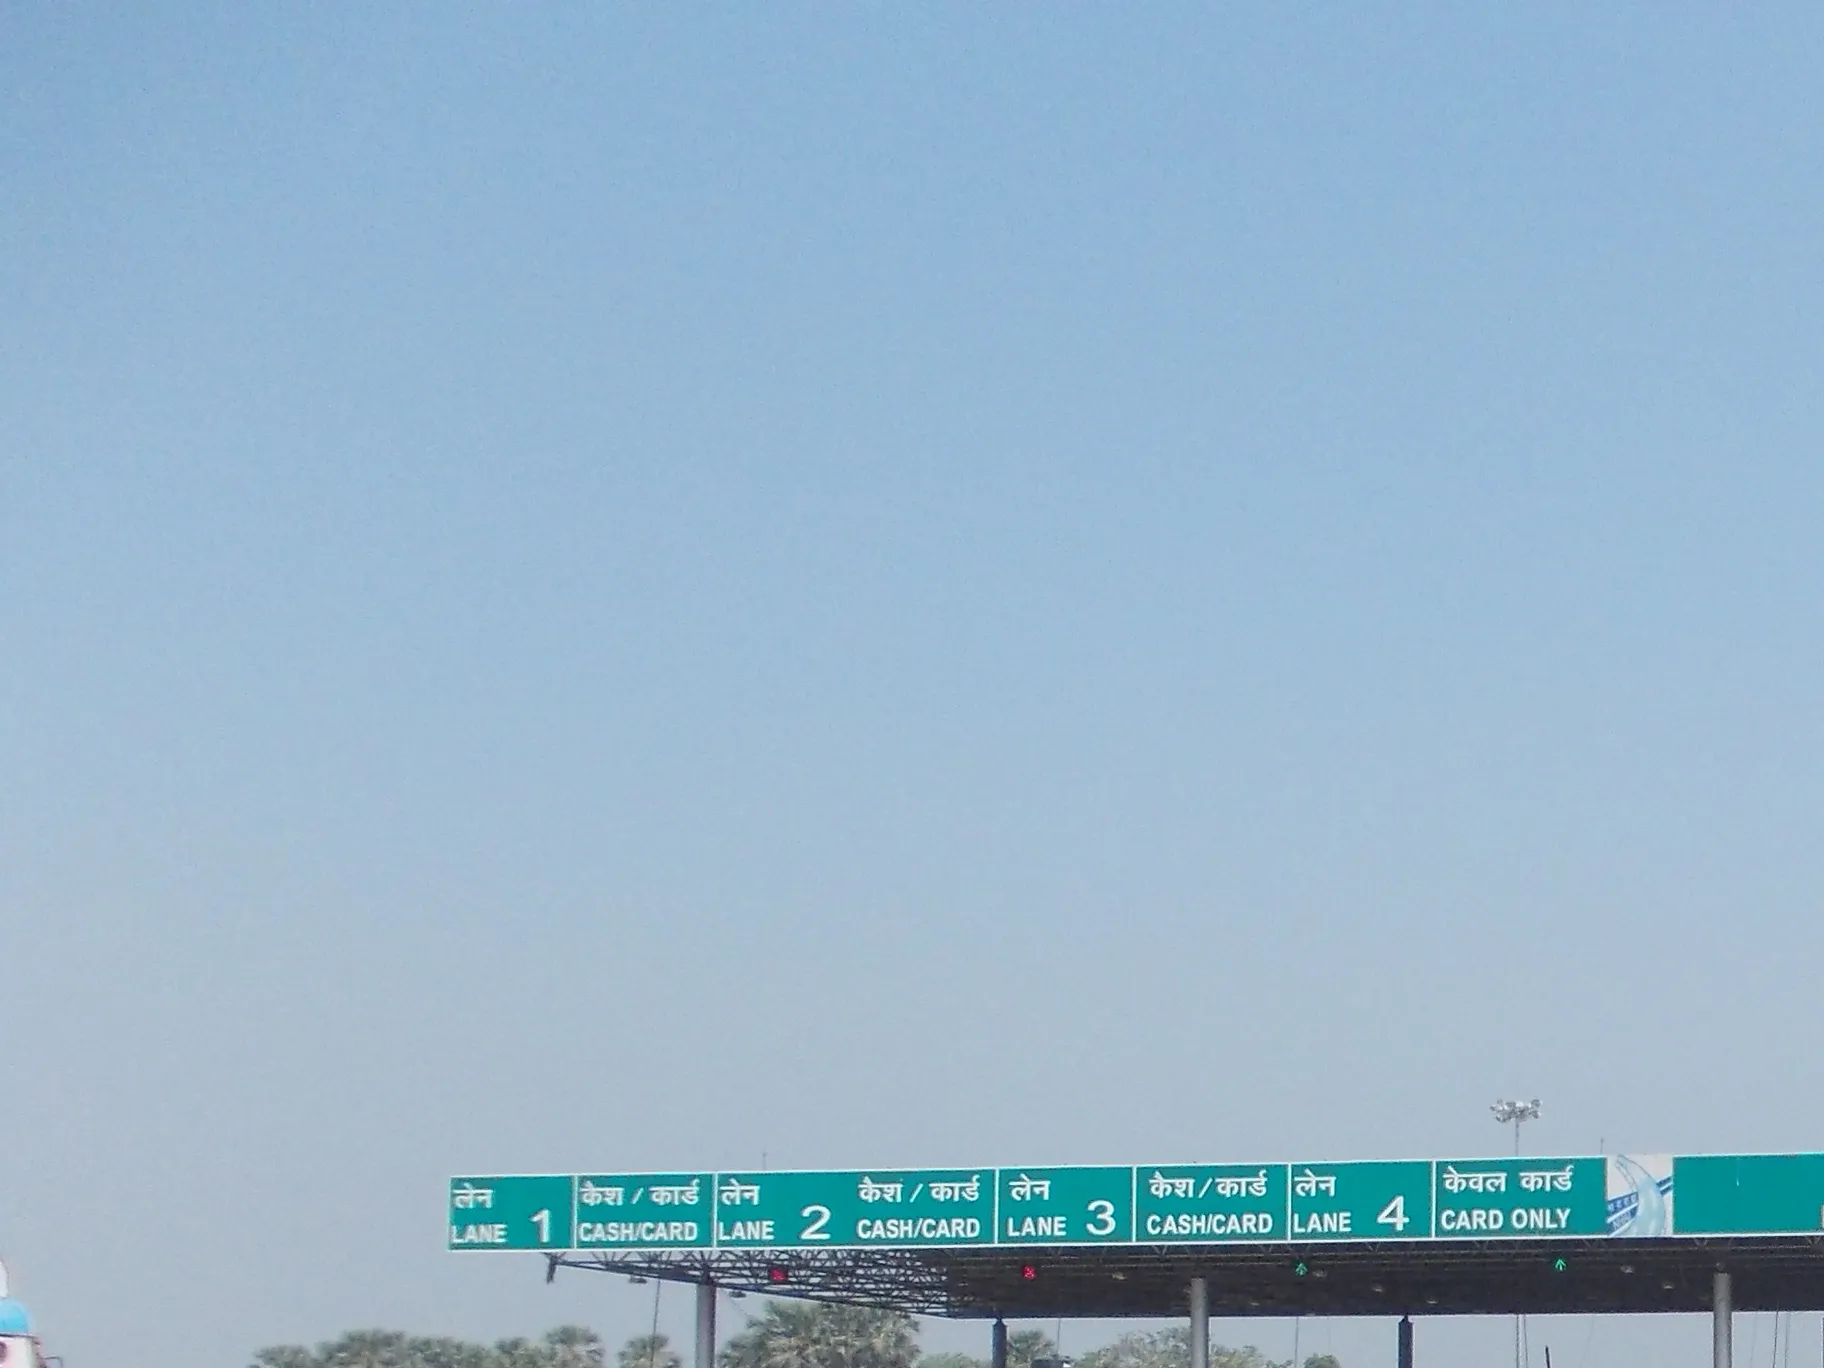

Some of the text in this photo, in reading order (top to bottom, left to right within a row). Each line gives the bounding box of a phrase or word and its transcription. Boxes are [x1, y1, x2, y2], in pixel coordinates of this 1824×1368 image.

[579, 1180, 623, 1205] कैश
[649, 1178, 700, 1205] कार्ड
[720, 1179, 760, 1204] लेन
[859, 1177, 903, 1202] कैश
[929, 1175, 980, 1201] कार्ड
[1008, 1174, 1050, 1200] लेन
[1149, 1170, 1194, 1198] कैश
[1215, 1169, 1268, 1197] कार्ड
[1294, 1169, 1337, 1196] लेन
[1443, 1165, 1574, 1192] केवल कार्ड
[452, 1183, 492, 1208] लेन
[451, 1208, 551, 1244] LANE 1
[718, 1205, 831, 1241] LANE 2
[1007, 1200, 1116, 1237] LANE 3
[1146, 1213, 1273, 1235] CASH/CARD
[1293, 1195, 1410, 1233] LANE 4
[1441, 1208, 1571, 1230] CARD ONLY
[578, 1221, 698, 1242] CASH/CARD
[857, 1218, 980, 1239] CASH/CARD
